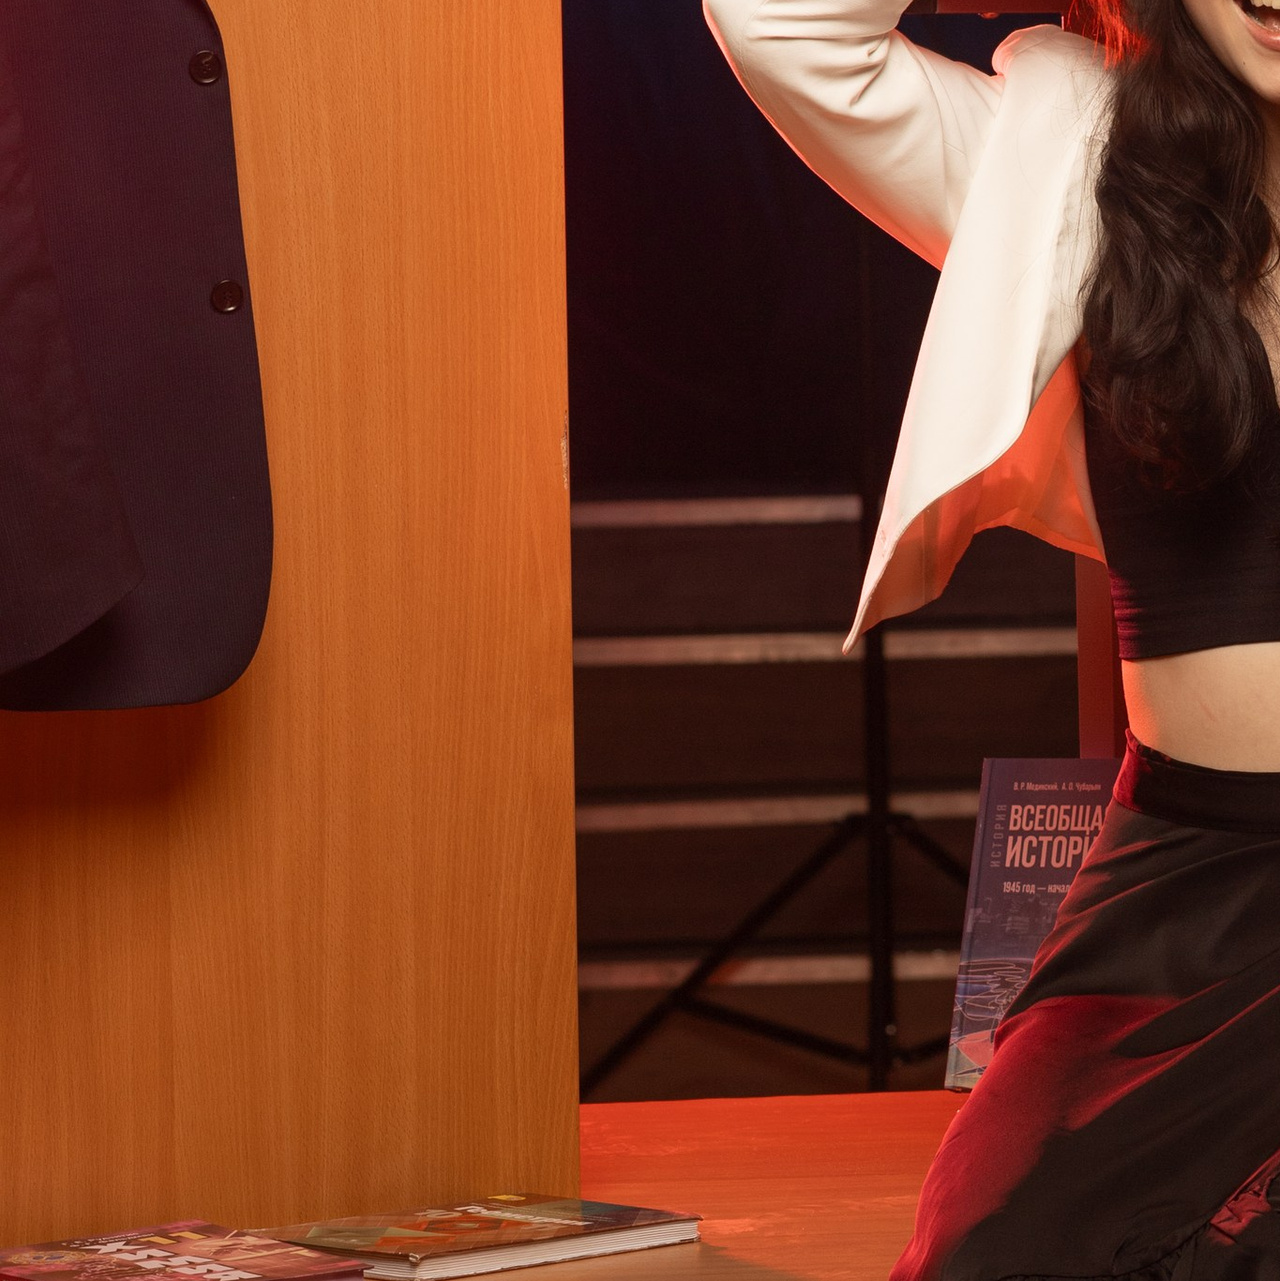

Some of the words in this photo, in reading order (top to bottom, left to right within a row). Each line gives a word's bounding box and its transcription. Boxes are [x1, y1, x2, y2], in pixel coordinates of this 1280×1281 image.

[1009, 804, 1106, 835] ВСЕОБЩА
[990, 804, 1007, 868] ИСТОРИЯ
[1002, 881, 1021, 894] 1945
[1021, 883, 1035, 895] год
[140, 1231, 207, 1245] 11
[79, 1240, 263, 1281] ХИМИЯ
